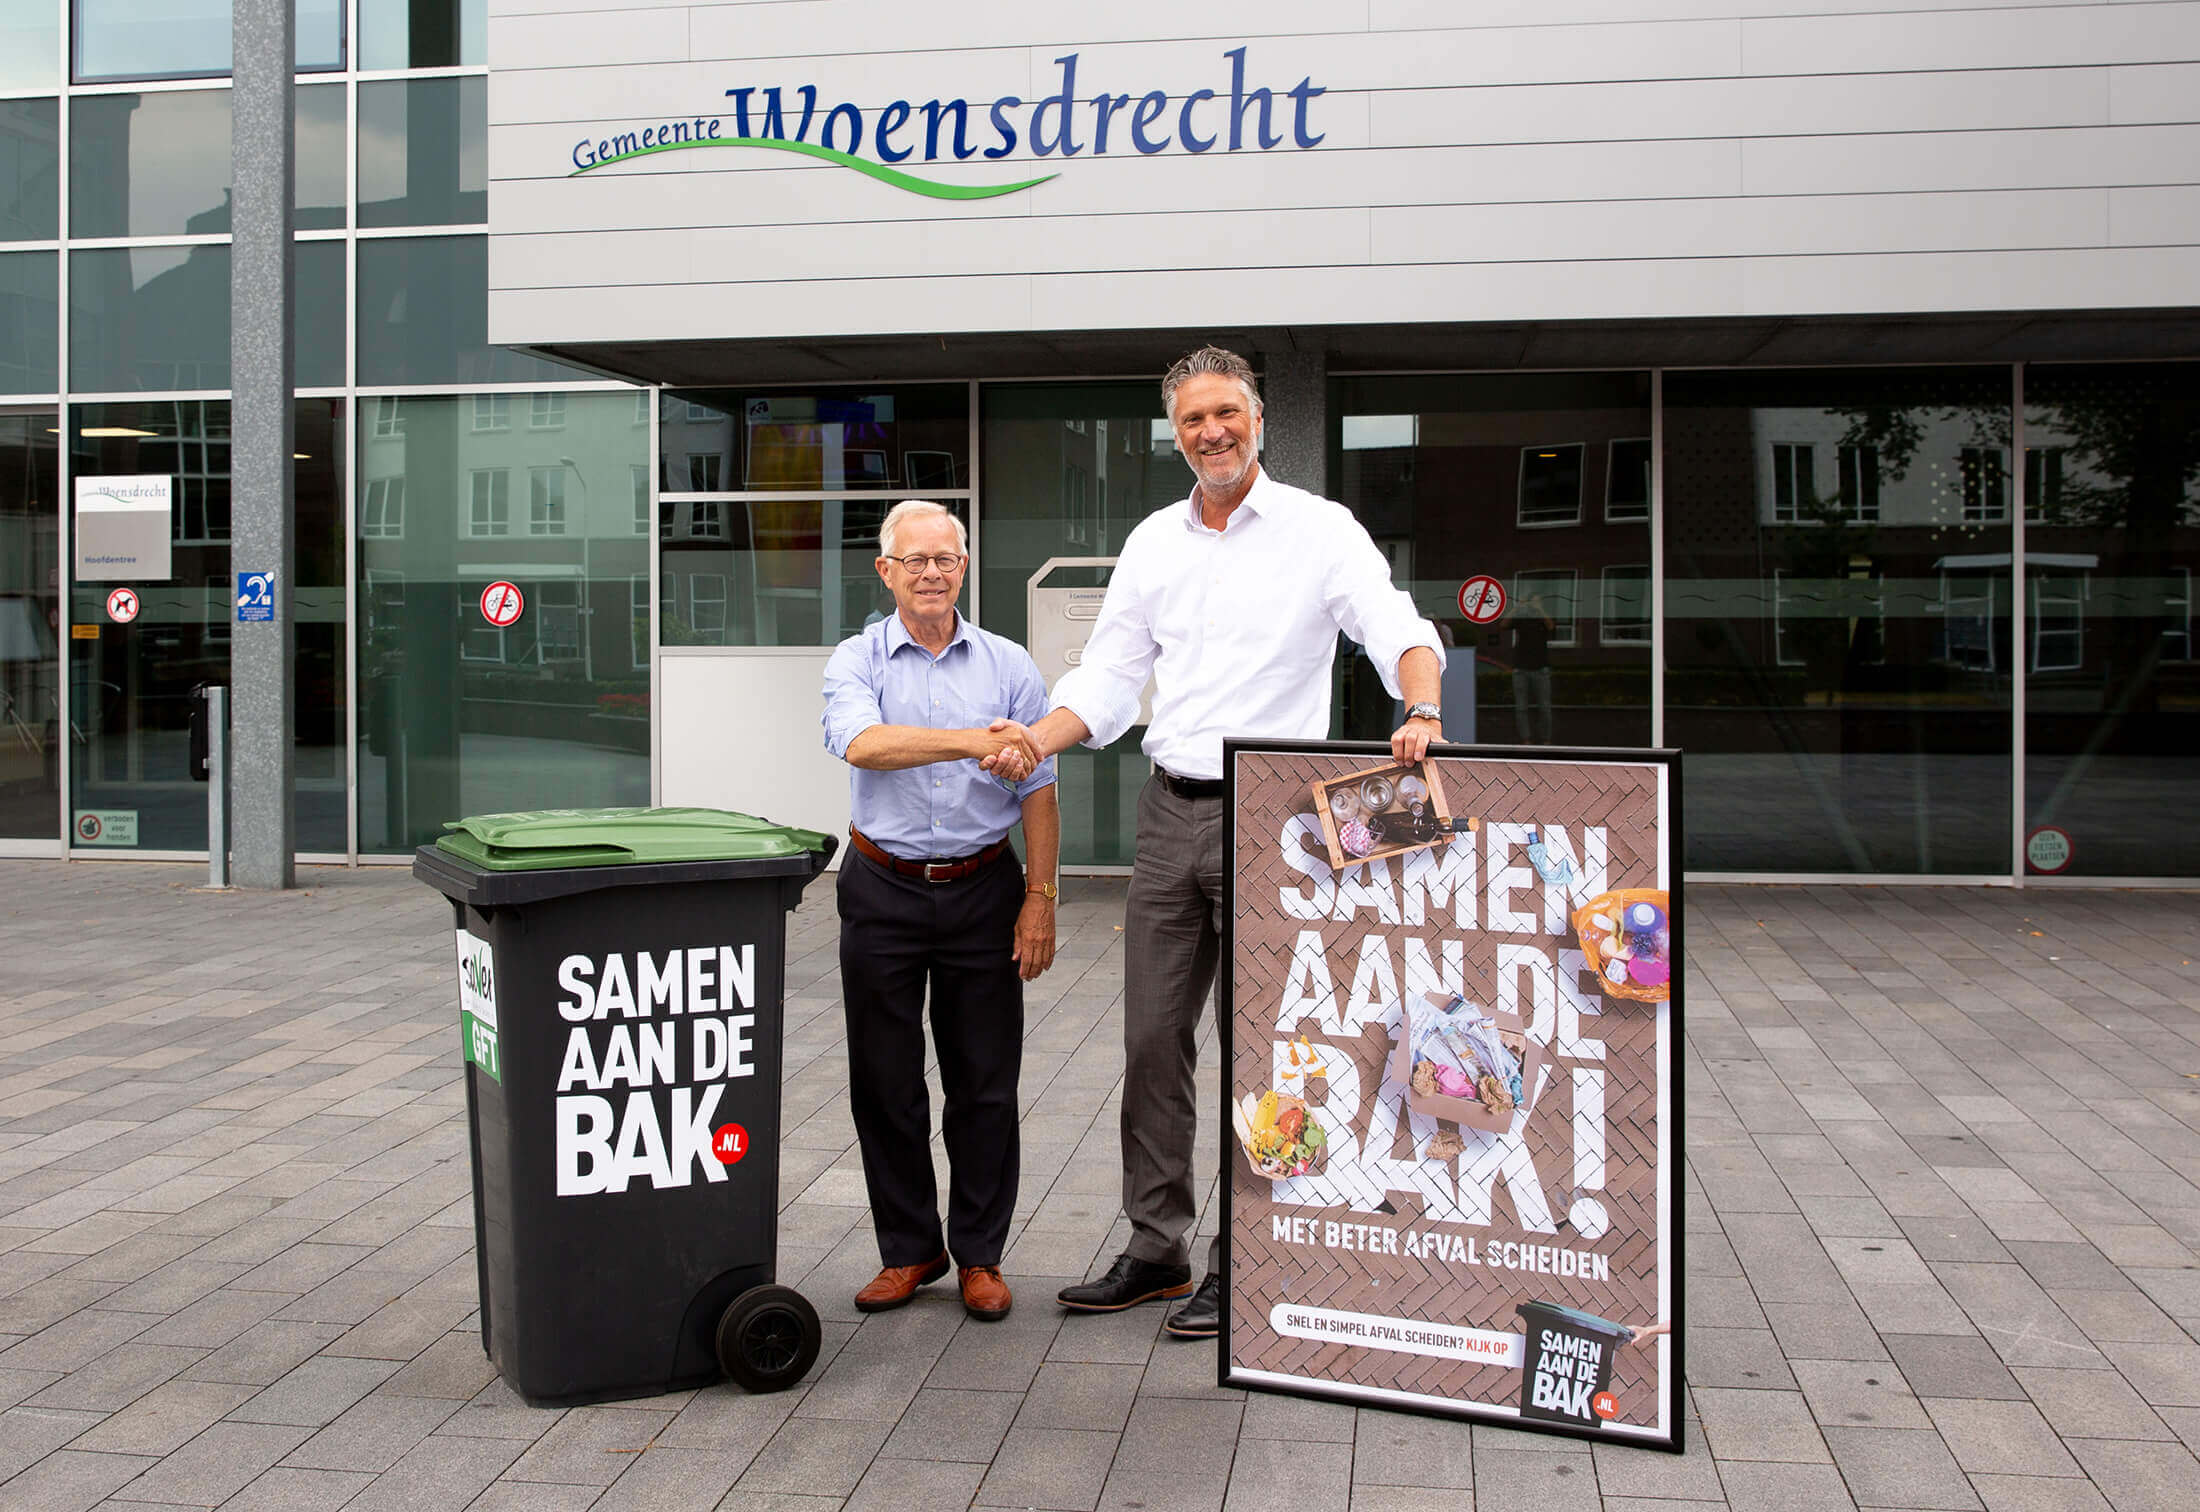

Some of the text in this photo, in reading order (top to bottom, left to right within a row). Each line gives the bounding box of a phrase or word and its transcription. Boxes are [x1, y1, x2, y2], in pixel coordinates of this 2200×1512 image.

[572, 46, 1327, 171] Gemeente Woensdrecht
[98, 484, 166, 498] Woensdrecht
[84, 556, 137, 564] Hoofdentree
[1279, 813, 1608, 936] SAMEN
[557, 944, 755, 1022] SAMEN
[1497, 943, 1607, 1061] DE
[472, 1020, 498, 1073] GFT
[556, 1014, 755, 1092] AAN DE
[556, 1083, 742, 1197] BAK .NL
[1272, 1215, 1609, 1281] MET BETER AFVAL SCHEIDEN
[1286, 1314, 1509, 1355] SNEL EN SIMPEL AFVAL SCHEIDEN? KIJK OP
[1540, 1329, 1602, 1364] SAMEN
[1531, 1371, 1614, 1420] BAK .NL
[1536, 1351, 1599, 1385] AAN DE
